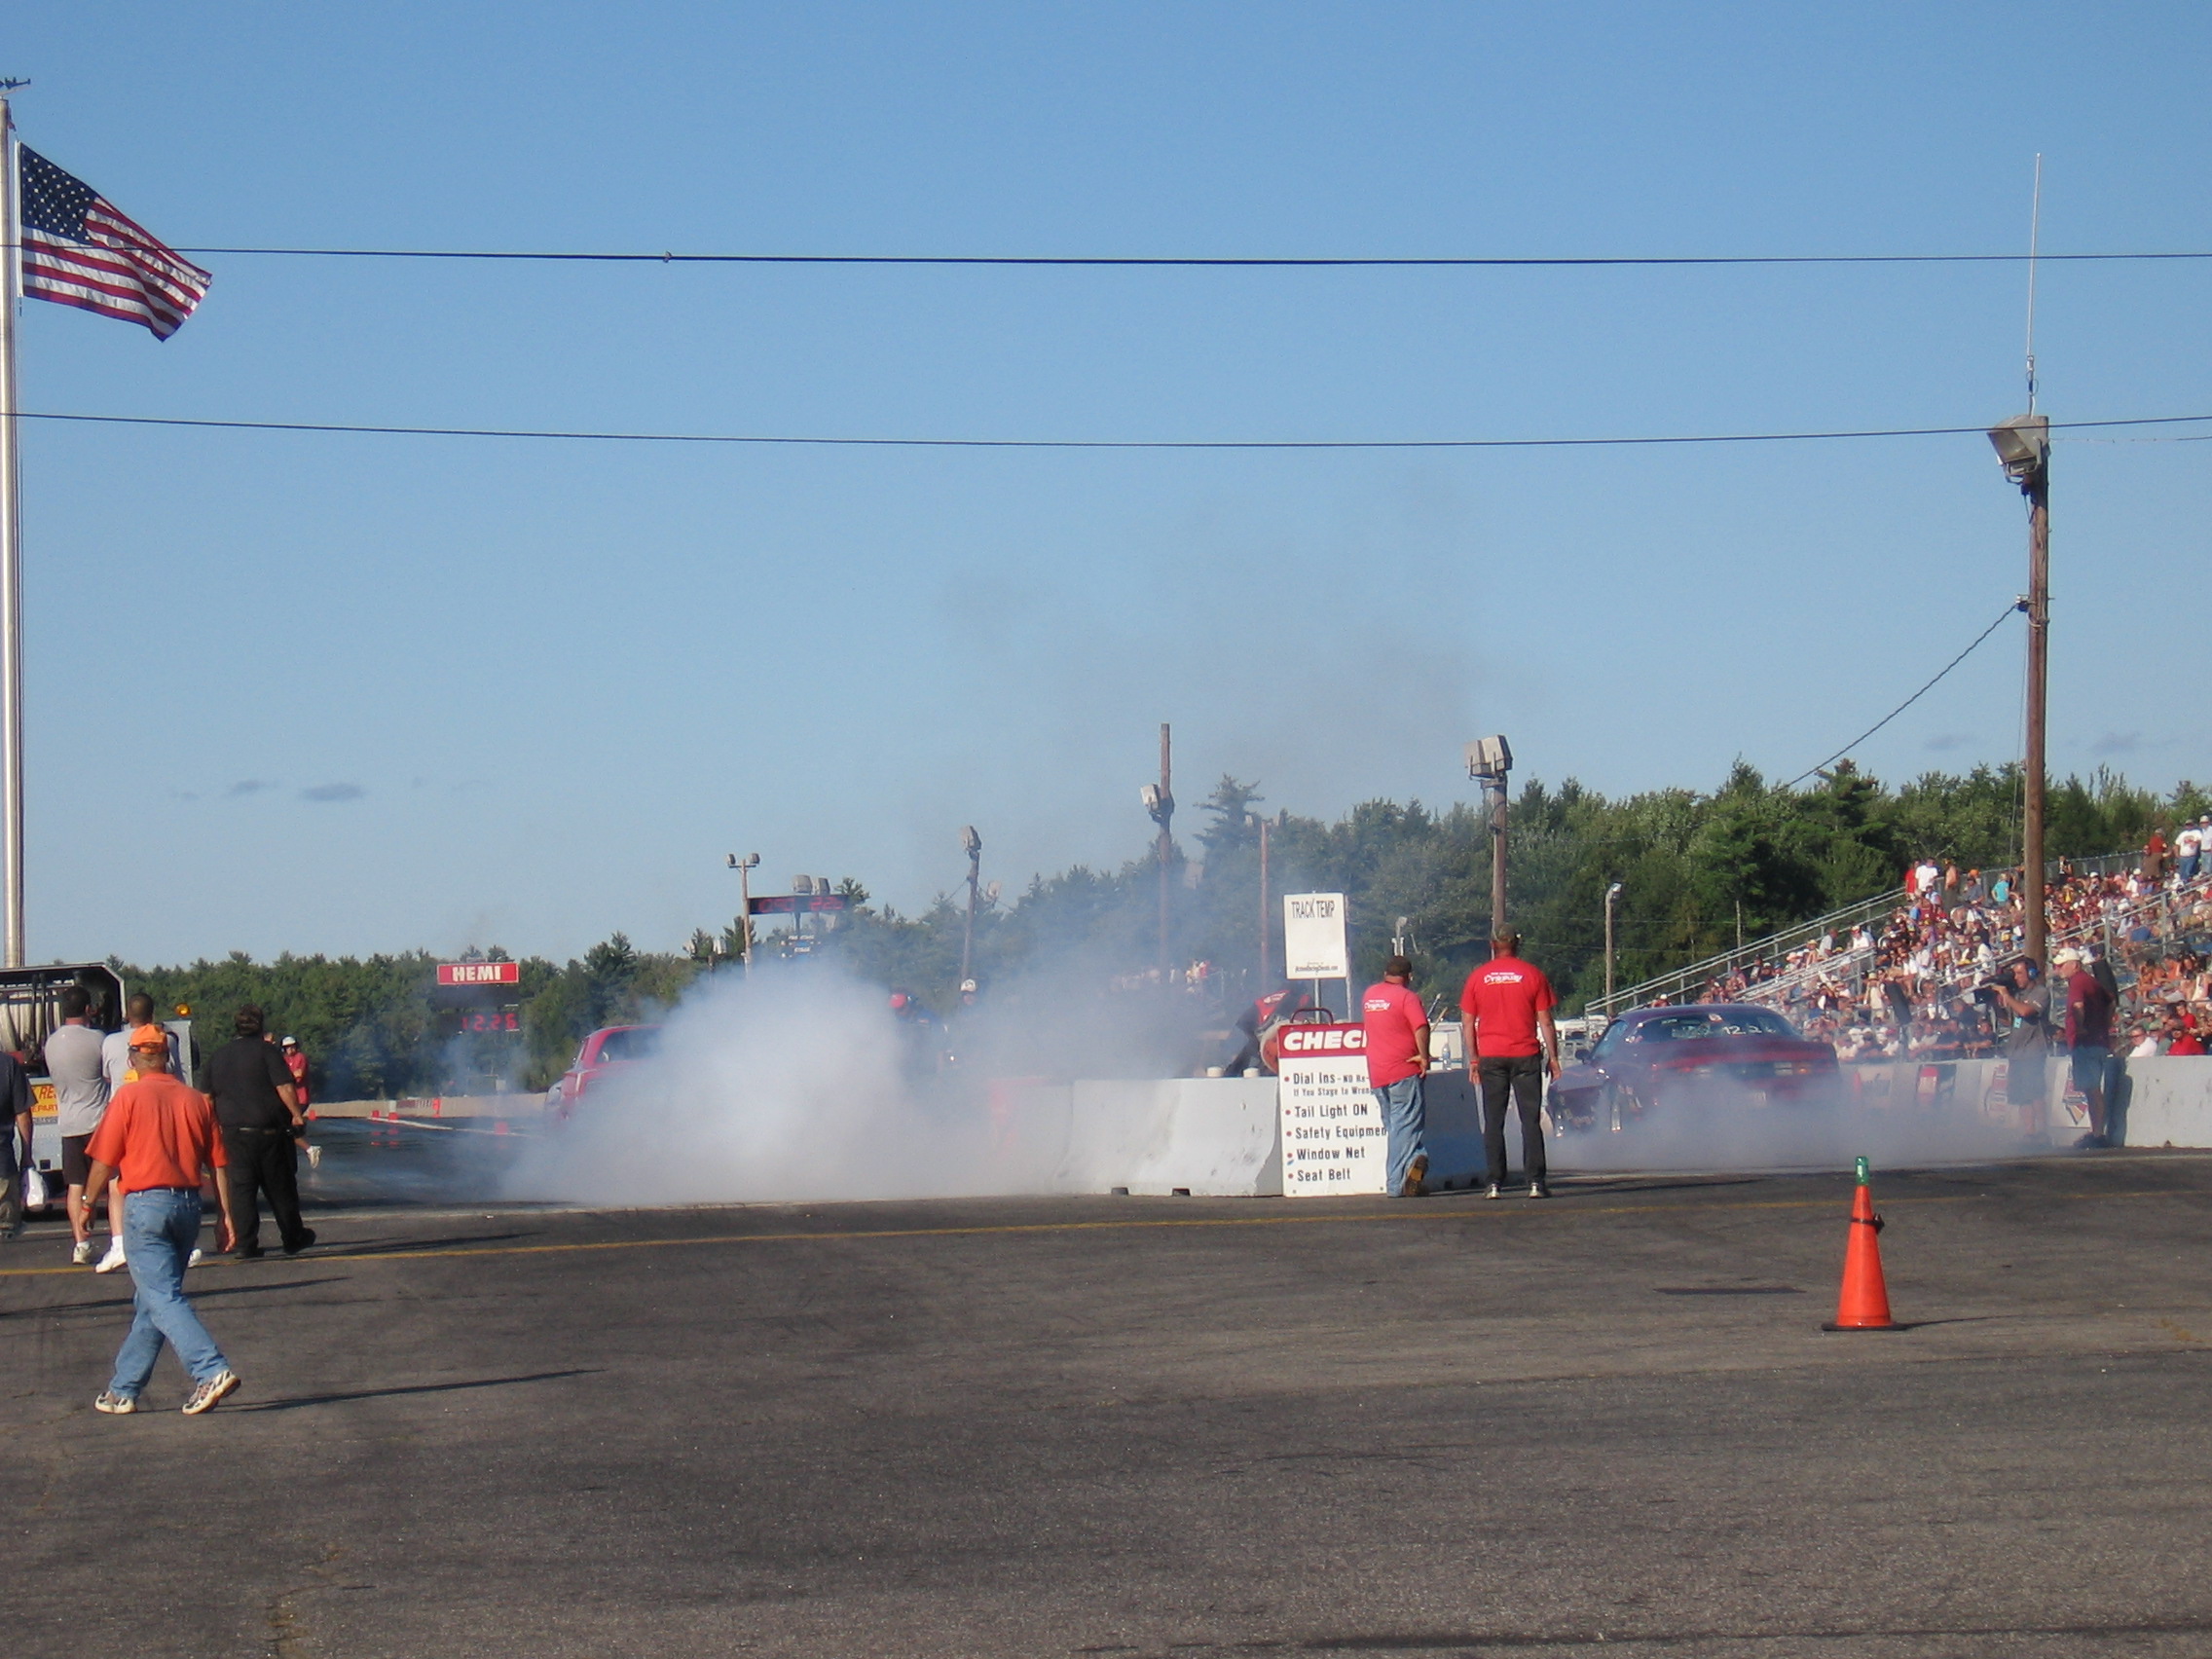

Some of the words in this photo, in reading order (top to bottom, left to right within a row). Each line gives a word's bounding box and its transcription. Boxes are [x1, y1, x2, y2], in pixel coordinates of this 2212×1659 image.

[1291, 898, 1316, 918] TRACK
[1316, 900, 1336, 918] TEMP
[452, 965, 502, 982] HEMI
[1293, 1072, 1314, 1085] Dial
[1317, 1088, 1339, 1097] Stage
[1294, 1105, 1315, 1119] Tail
[1319, 1104, 1347, 1120] Light
[1352, 1103, 1368, 1116] ON
[1295, 1126, 1331, 1140] Safety
[1296, 1148, 1341, 1161] Window
[1346, 1146, 1365, 1159] Net
[1297, 1169, 1322, 1182] Seat
[1328, 1168, 1351, 1181] Belt
